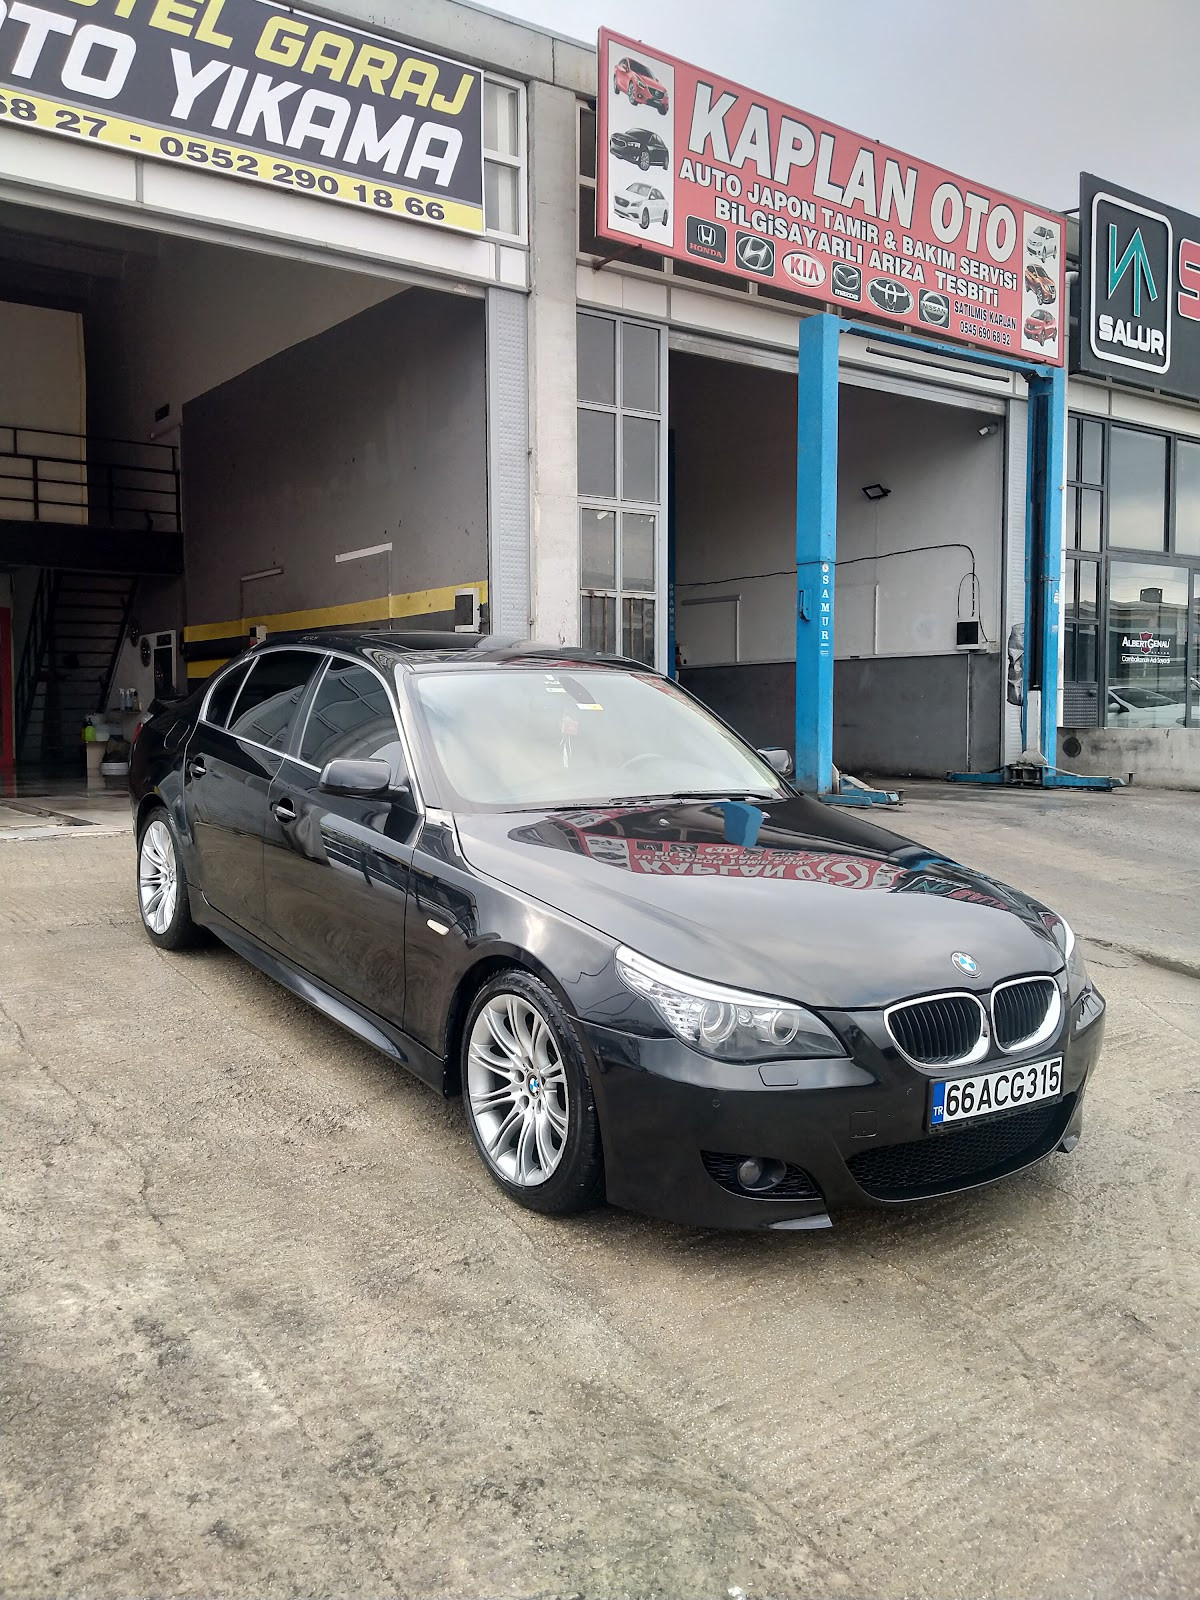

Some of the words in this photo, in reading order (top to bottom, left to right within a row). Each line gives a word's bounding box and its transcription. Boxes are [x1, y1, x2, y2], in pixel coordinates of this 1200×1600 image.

[254, 15, 475, 115] GARAJ
[0, 0, 137, 100] TO
[170, 48, 463, 188] YIKAMA
[55, 110, 107, 138] 27
[160, 136, 259, 176] 0552
[272, 163, 339, 195] 290
[353, 183, 393, 209] 18
[405, 197, 445, 221] 66
[688, 80, 918, 229] KAPLAN
[930, 182, 1017, 263] OTO
[679, 158, 742, 197] AUTO
[748, 183, 816, 224] JAPON
[884, 230, 898, 251] &
[902, 235, 957, 271] BAKIM
[689, 242, 723, 259] HONDA
[791, 256, 819, 281] KIA
[868, 249, 926, 284] ARIZA
[922, 302, 947, 315] NISSAN
[989, 311, 1017, 331] KAPLAN
[960, 320, 977, 337] 0545
[979, 326, 991, 340] 690
[992, 330, 1001, 343] 68
[1002, 333, 1011, 346] 92
[1098, 313, 1165, 357] SALUR
[933, 1105, 943, 1116] TR
[946, 1060, 1061, 1117] 66ACG315
